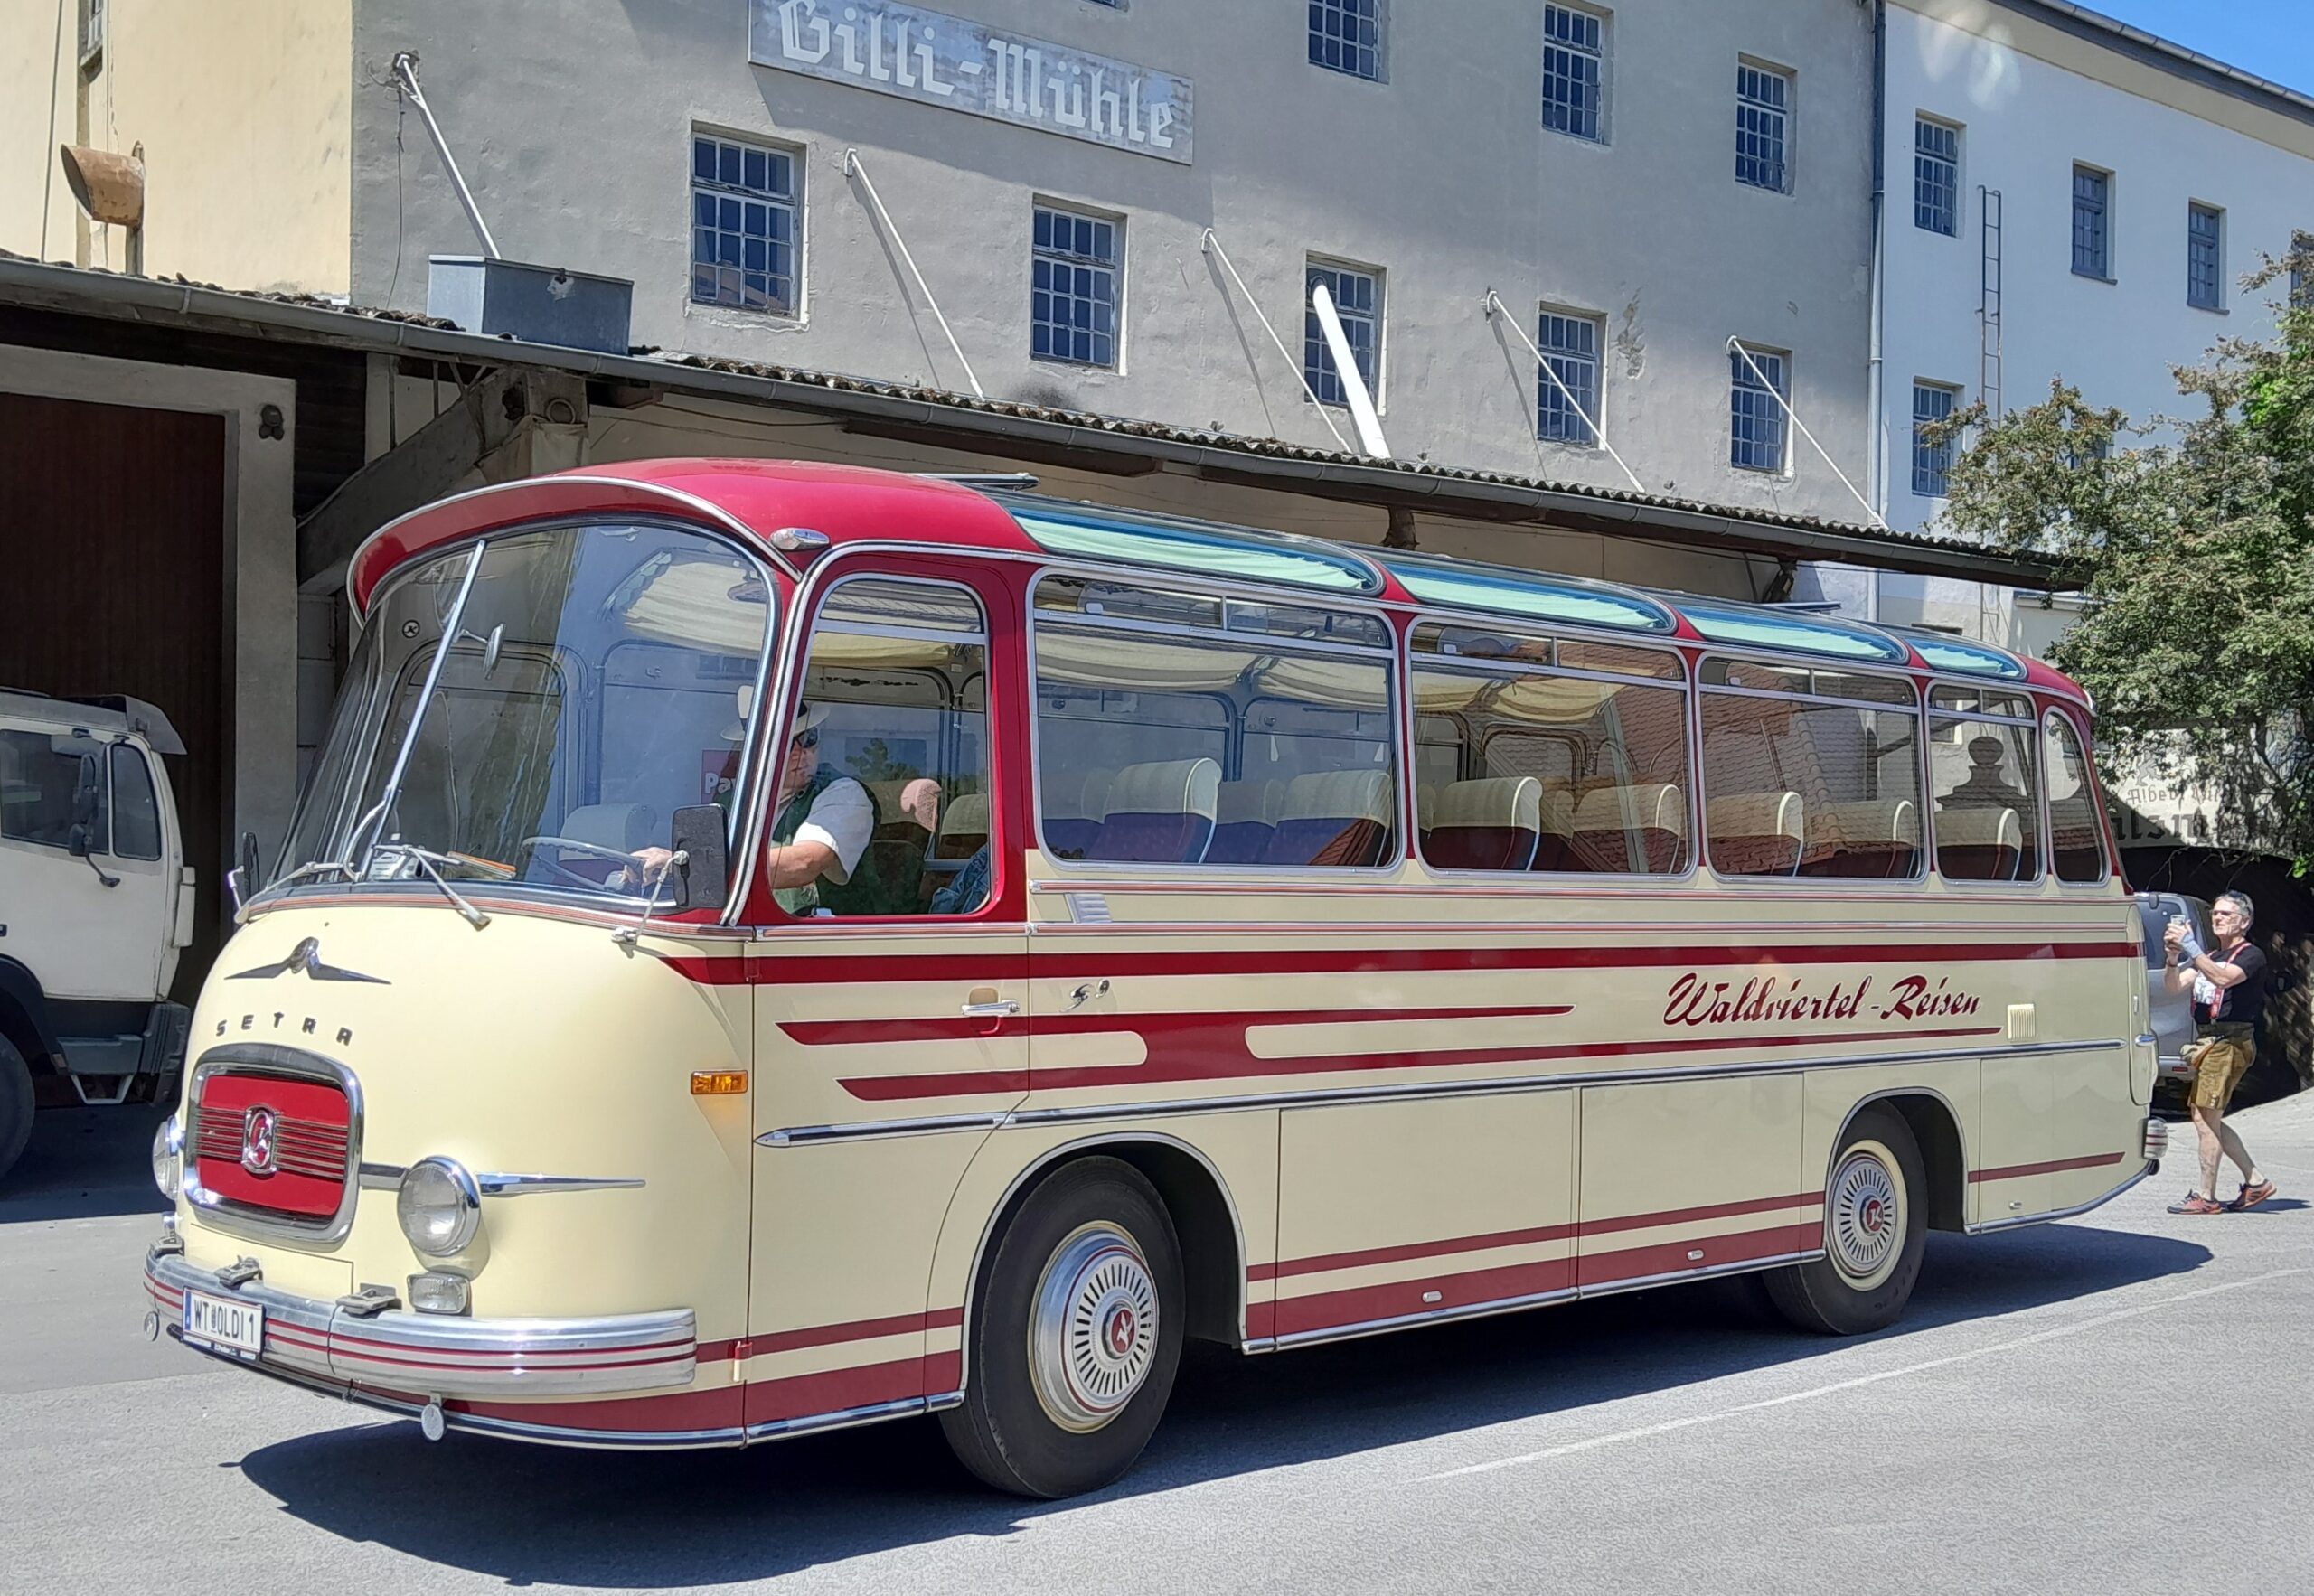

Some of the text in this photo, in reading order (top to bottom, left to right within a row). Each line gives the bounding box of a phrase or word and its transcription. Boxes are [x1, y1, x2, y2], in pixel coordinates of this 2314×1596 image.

[705, 772, 732, 794] Pa
[216, 1011, 353, 1046] SETRA
[193, 1299, 209, 1332] WT
